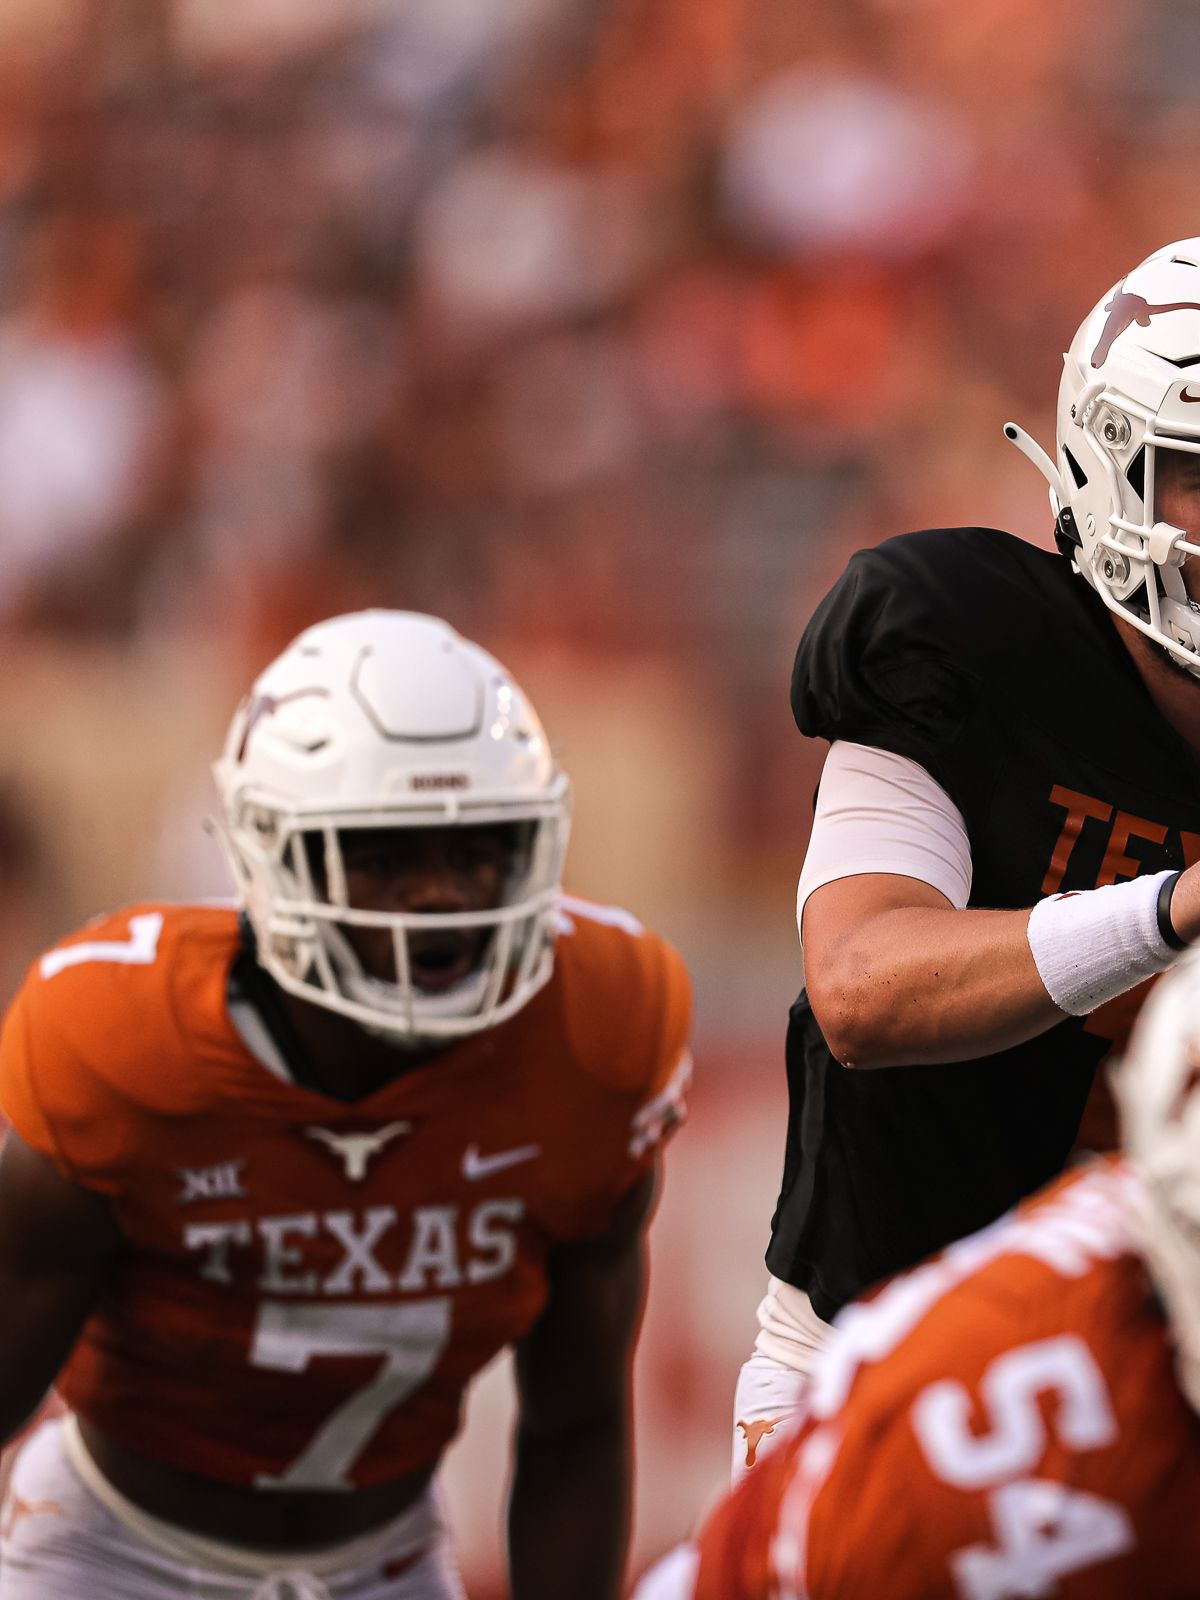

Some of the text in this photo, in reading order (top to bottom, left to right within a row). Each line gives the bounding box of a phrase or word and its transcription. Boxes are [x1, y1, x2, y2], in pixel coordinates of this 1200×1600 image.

[184, 1201, 524, 1293] TEXAS
[250, 1299, 453, 1490] 7
[910, 1335, 1130, 1600] 54
